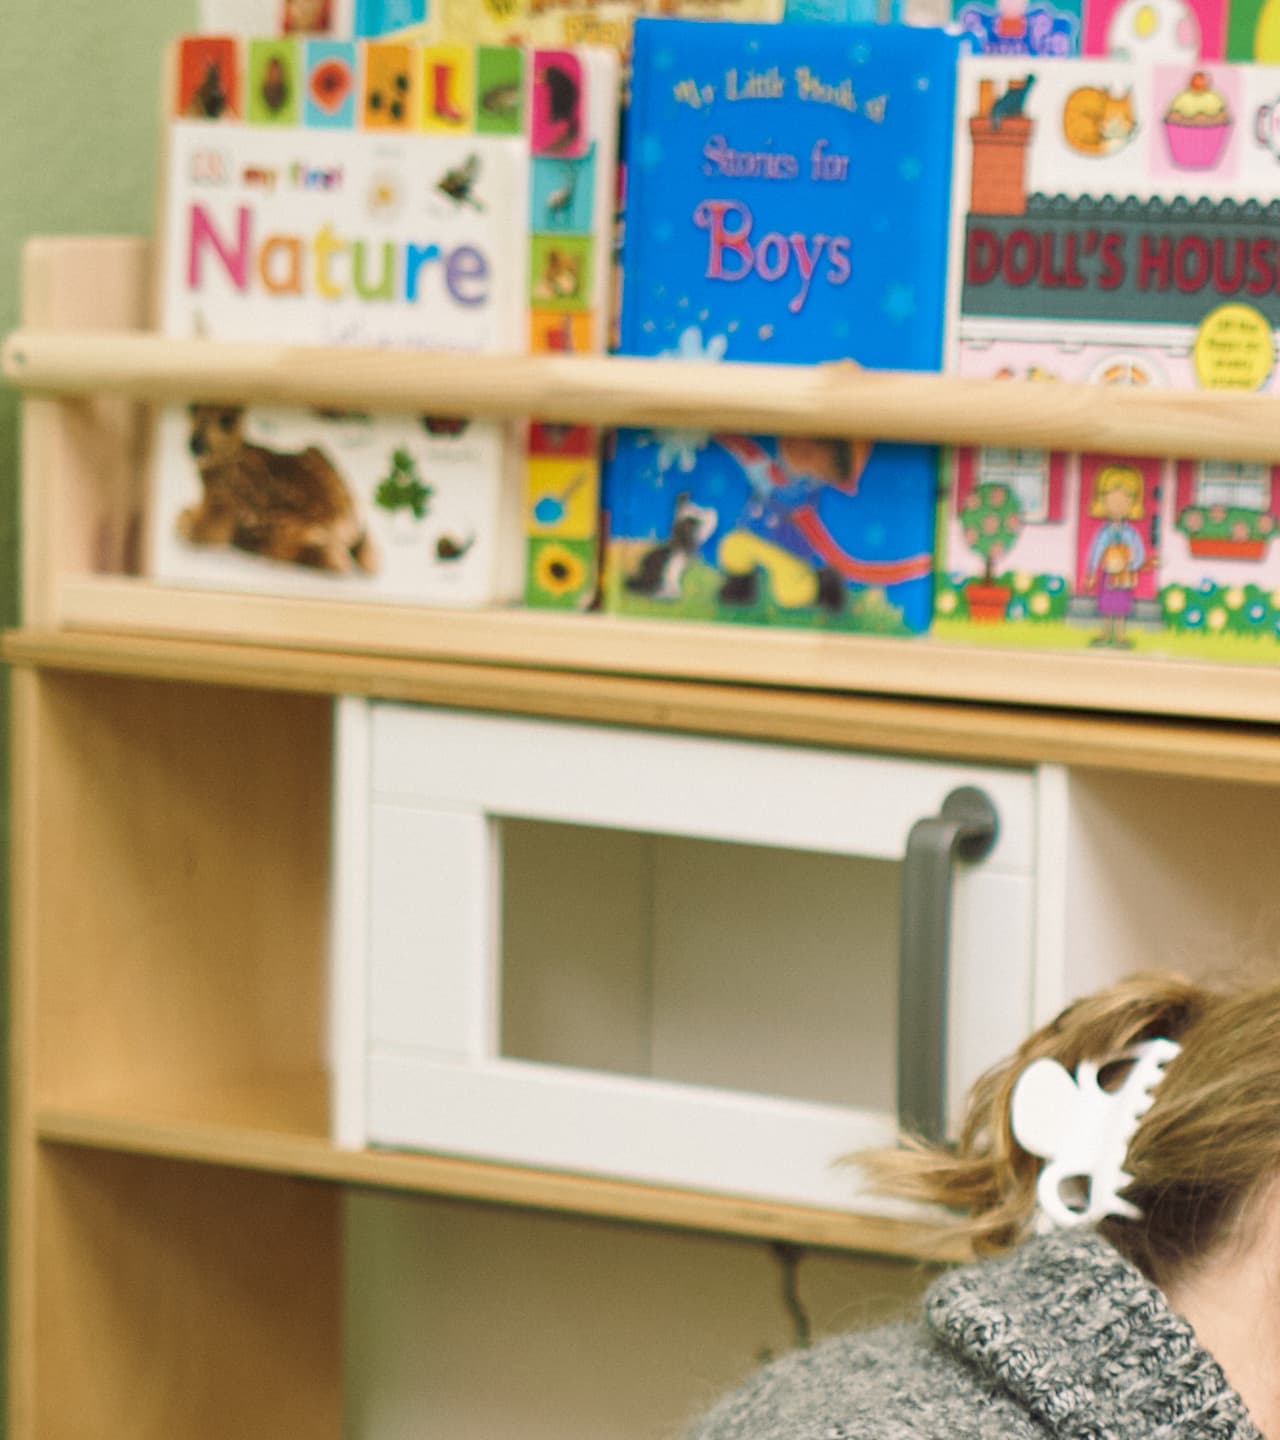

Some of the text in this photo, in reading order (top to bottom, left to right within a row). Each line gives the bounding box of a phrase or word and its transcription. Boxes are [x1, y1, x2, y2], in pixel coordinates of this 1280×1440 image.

[703, 133, 850, 181] Stories for
[186, 202, 490, 308] Nature
[692, 198, 852, 314] Boys
[965, 228, 1124, 291] DOLL'S
